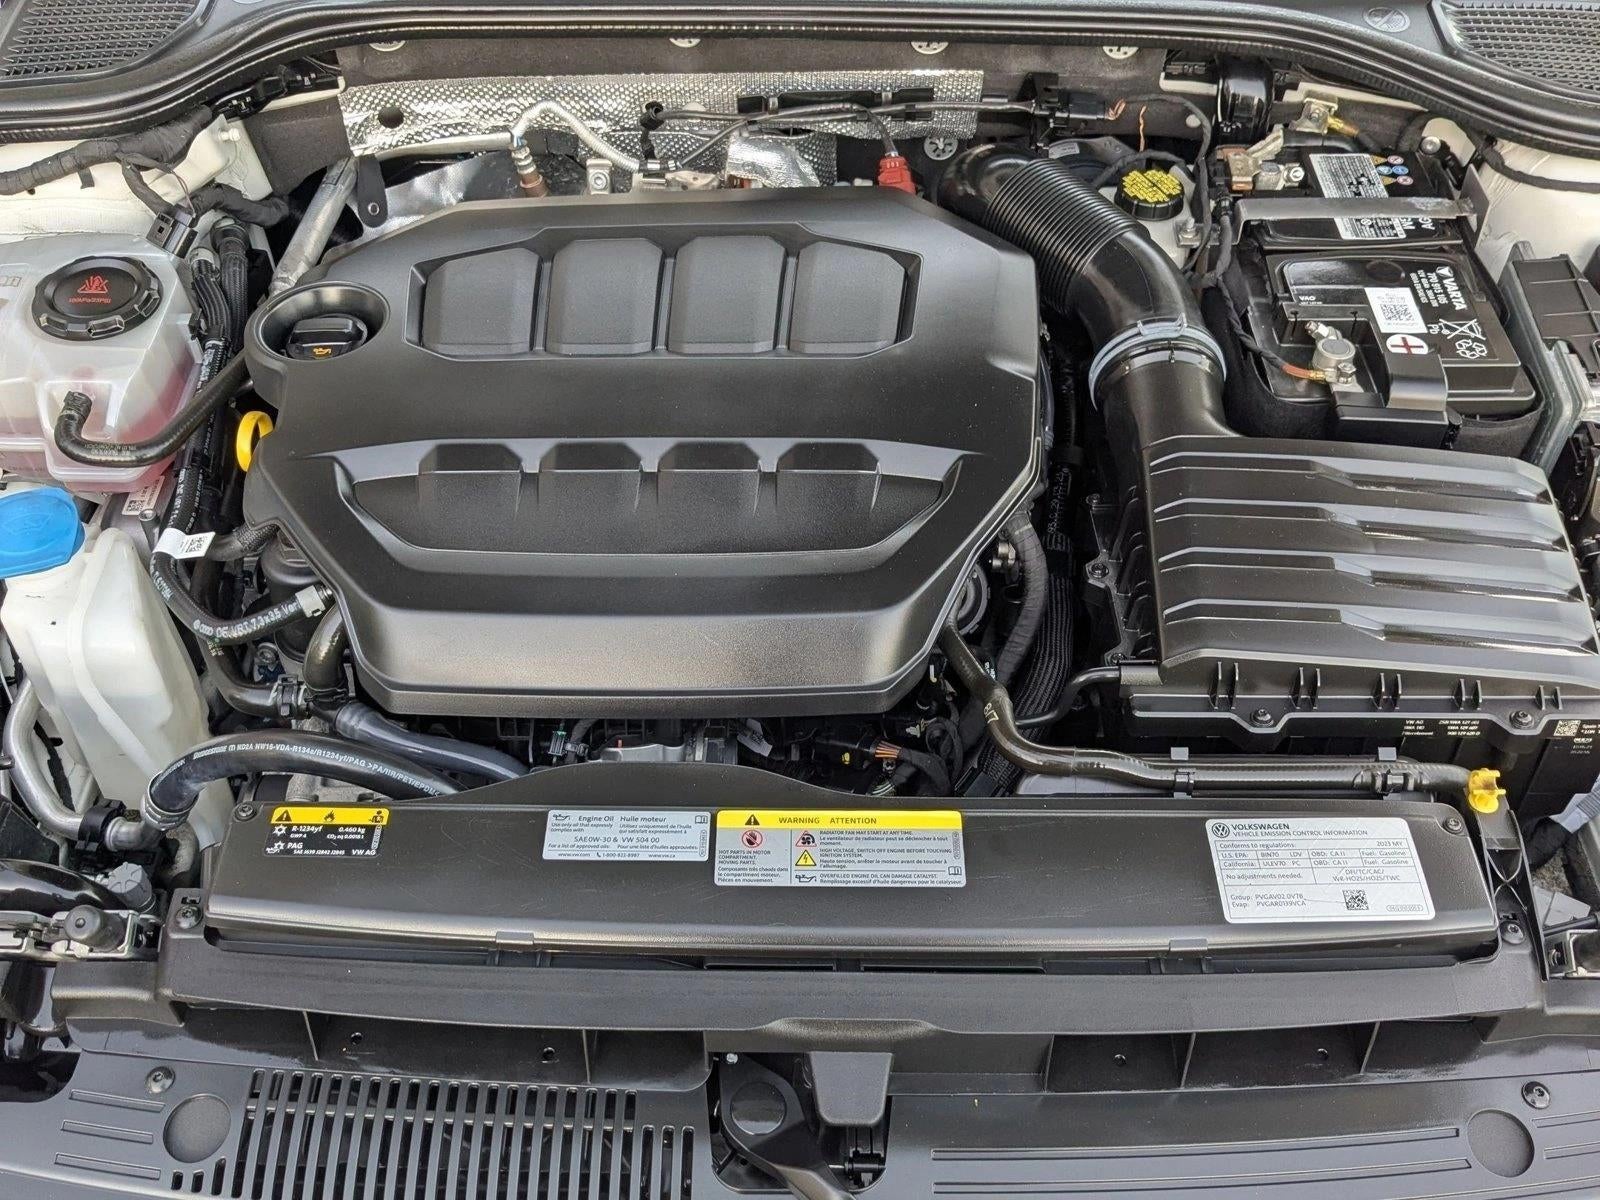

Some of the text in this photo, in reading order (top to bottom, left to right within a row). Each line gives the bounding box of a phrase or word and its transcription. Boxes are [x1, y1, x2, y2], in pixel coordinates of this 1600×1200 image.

[1431, 283, 1443, 294] 915
[1443, 278, 1468, 310] VARTA
[1427, 324, 1440, 334] Pb
[291, 825, 323, 834] R-1234yf
